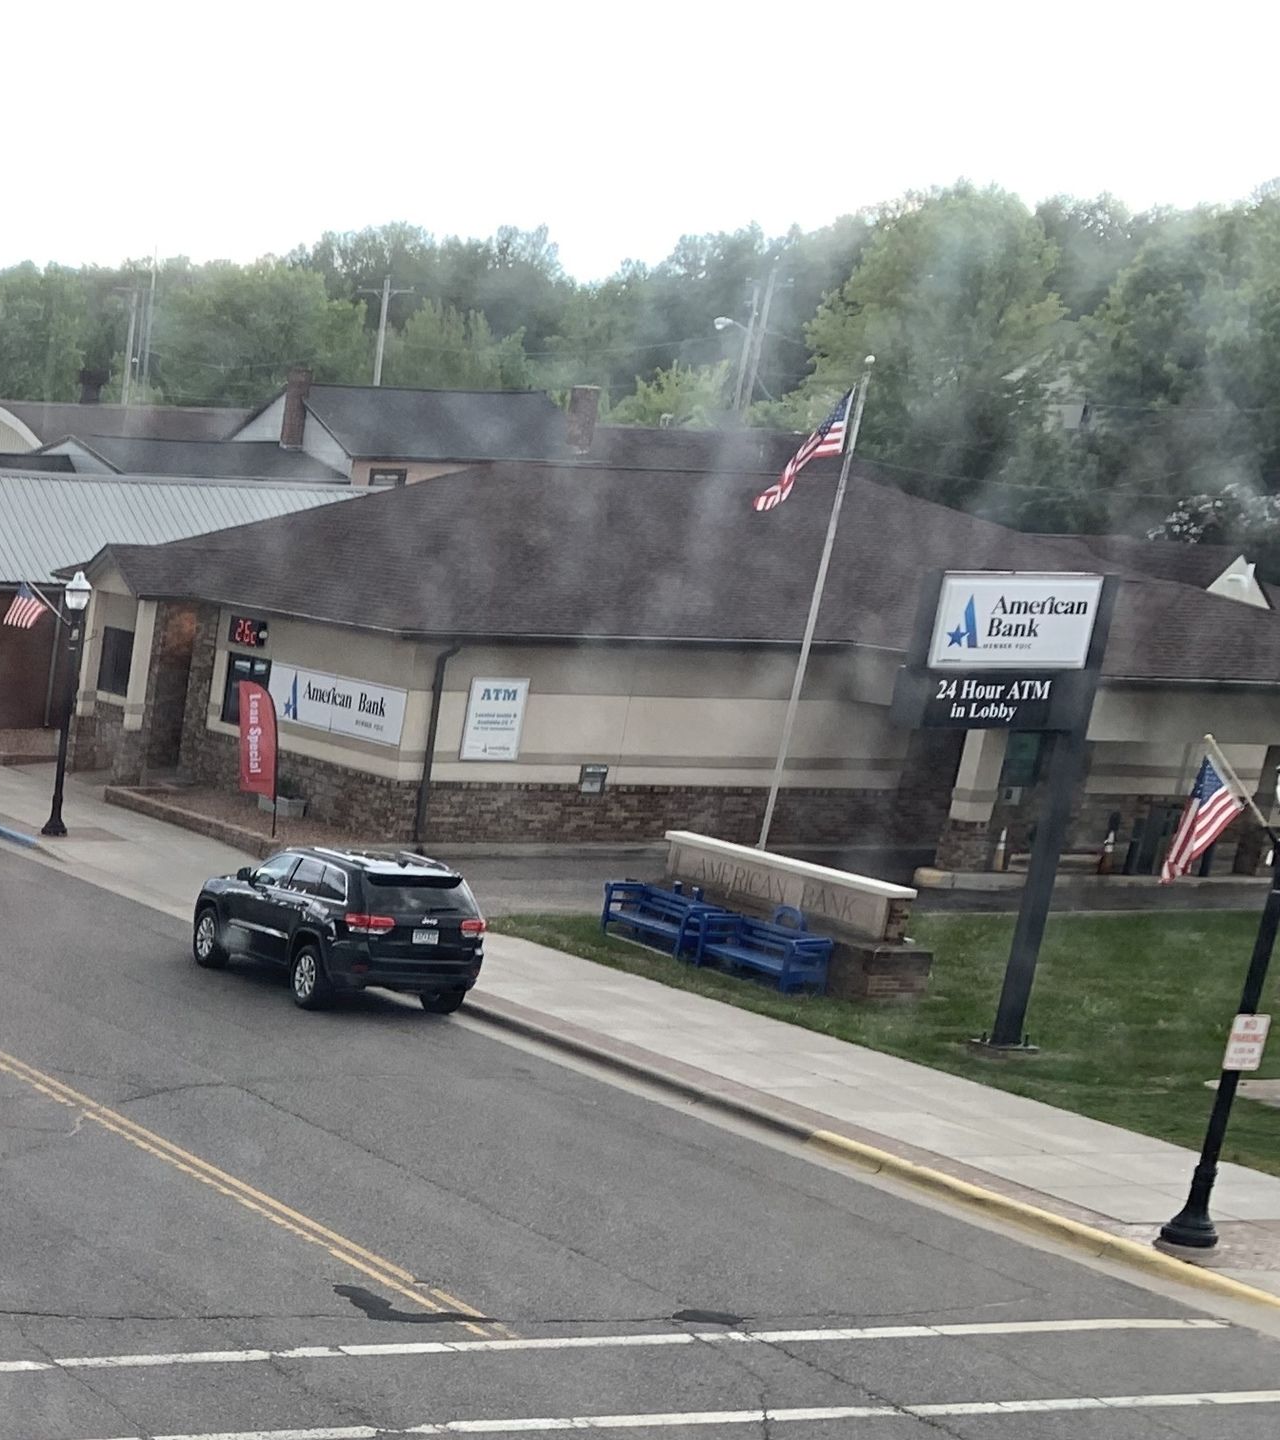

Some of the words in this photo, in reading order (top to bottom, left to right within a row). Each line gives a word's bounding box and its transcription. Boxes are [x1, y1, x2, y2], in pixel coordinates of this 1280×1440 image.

[990, 595, 1088, 616] American
[987, 617, 1040, 638] Bank
[303, 680, 353, 710] American
[357, 692, 386, 718] Bank
[481, 687, 518, 701] ATM
[936, 680, 958, 700] 24
[960, 680, 1005, 700] Hour
[1006, 680, 1052, 700] ATM
[249, 693, 262, 724] Loan
[950, 703, 966, 718] in
[969, 703, 1018, 722] Lobby
[246, 726, 262, 774] Special
[694, 857, 789, 904] AMERICAN
[799, 885, 857, 921] BANK
